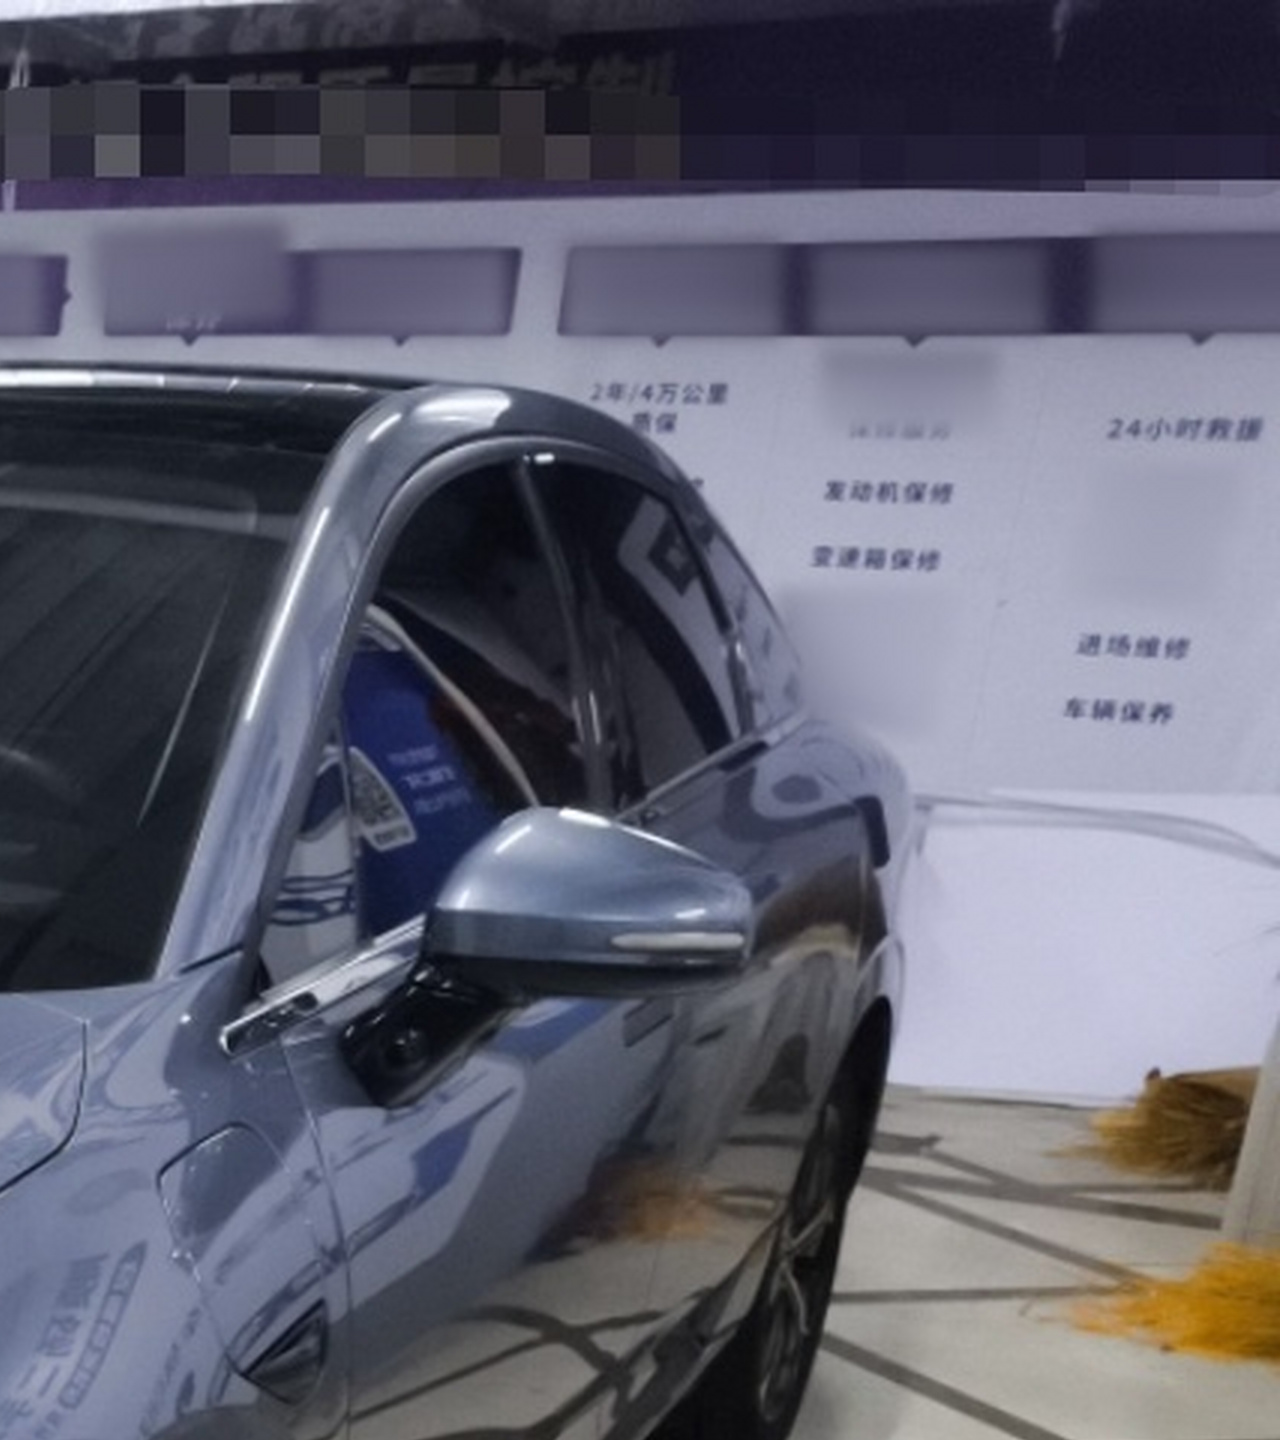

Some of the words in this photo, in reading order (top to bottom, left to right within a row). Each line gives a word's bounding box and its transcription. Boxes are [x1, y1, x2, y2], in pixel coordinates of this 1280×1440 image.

[590, 382, 728, 405] 2年/4万公里
[1106, 416, 1264, 443] 24小时救援
[824, 479, 954, 505] 发动机保修
[811, 545, 941, 573] 变速箱保修
[1076, 632, 1192, 661] 进场维修
[1063, 696, 1175, 726] 车辆保养
